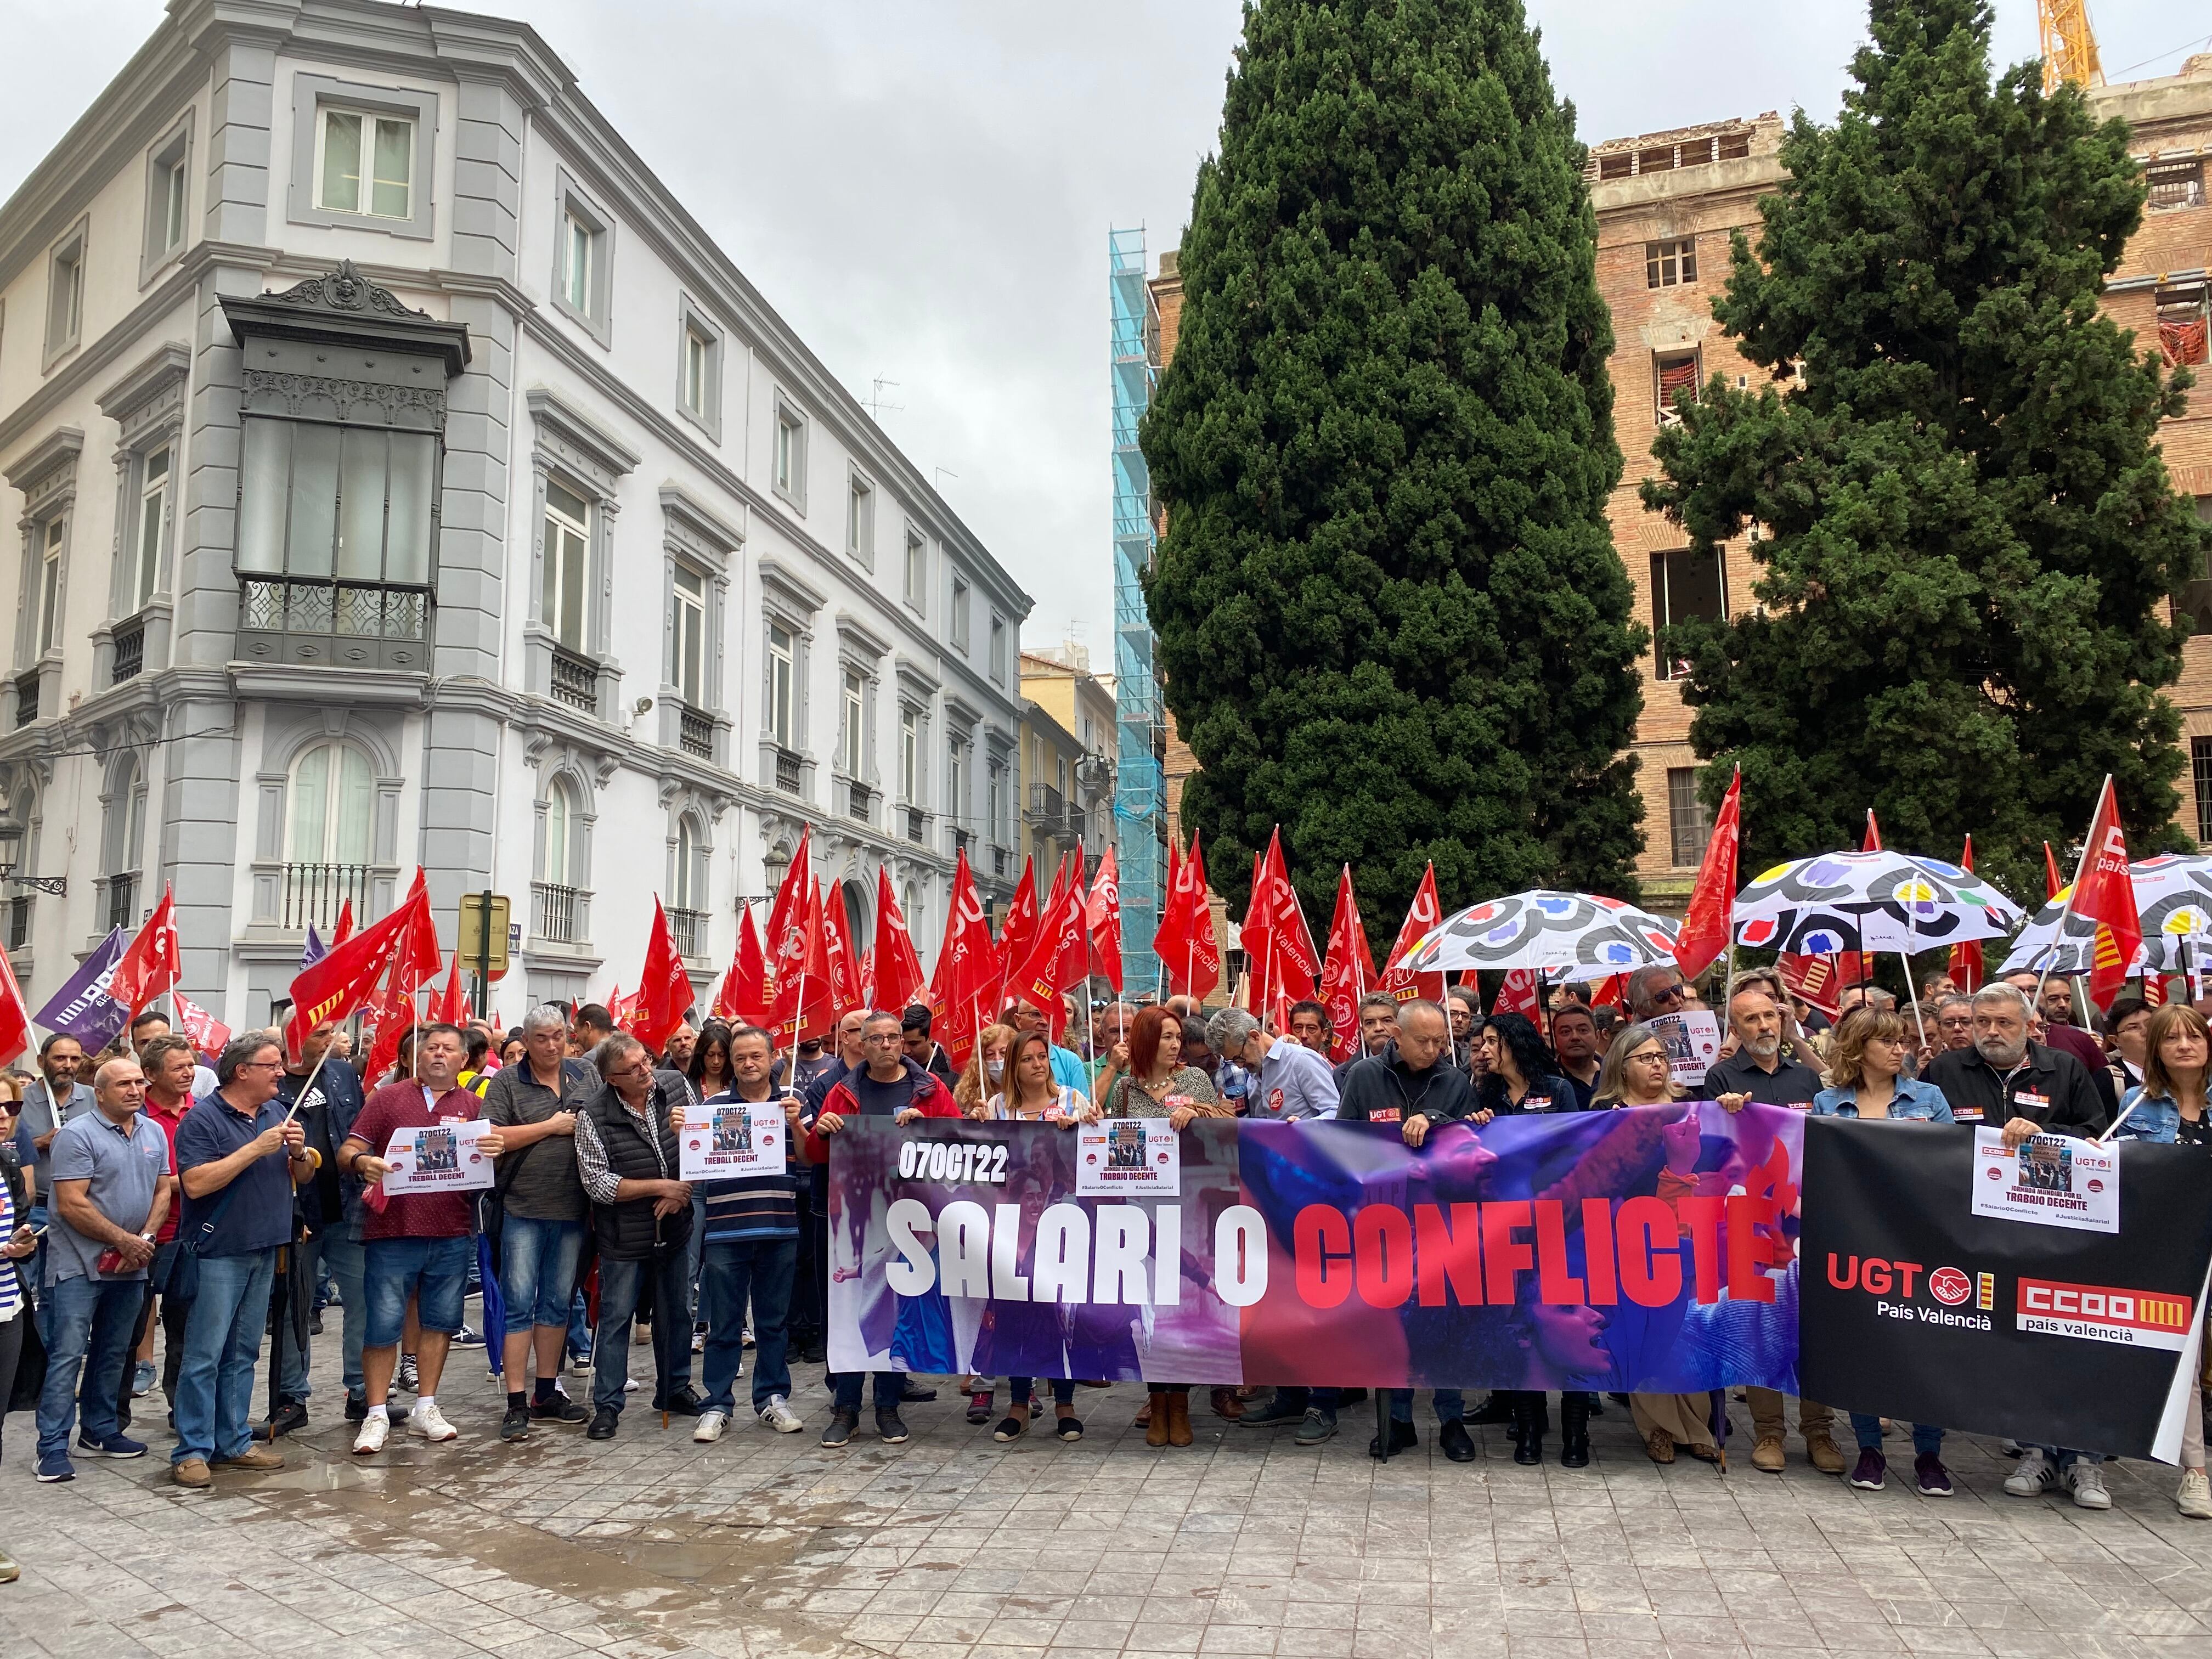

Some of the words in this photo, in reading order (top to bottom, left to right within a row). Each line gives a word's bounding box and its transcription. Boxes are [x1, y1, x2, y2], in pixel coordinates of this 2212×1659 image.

[2096, 857, 2129, 876] país
[1510, 969, 1536, 1011] GT
[1679, 1062, 1706, 1071] DECENTE
[303, 1098, 326, 1108] adidas
[1046, 1107, 1063, 1115] UGT
[1370, 1110, 1387, 1119] UGT
[704, 1156, 732, 1165] TREBALL
[733, 1154, 758, 1163] DECENT
[2075, 1158, 2096, 1167] UGT
[408, 1174, 437, 1182] TREBALL
[438, 1172, 465, 1180] DECENT
[1099, 1172, 1127, 1181] TRABAJO
[1129, 1172, 1158, 1181] DECENTE
[2011, 1185, 2036, 1194] JORNADA
[2037, 1188, 2063, 1197] MUNDIAL
[2006, 1192, 2045, 1205] TRABAJO
[2047, 1197, 2087, 1211] DECENTE
[885, 1198, 1181, 1306] SALARI
[1214, 1205, 1268, 1307] O
[1294, 1195, 1775, 1308] CONFLICTE
[1827, 1252, 1923, 1298] UGT
[2027, 1286, 2134, 1321] CCOO
[1877, 1301, 1914, 1321] País
[1917, 1306, 1991, 1330] Valencià
[2027, 1319, 2058, 1331] país
[2064, 1324, 2133, 1342] valencià
